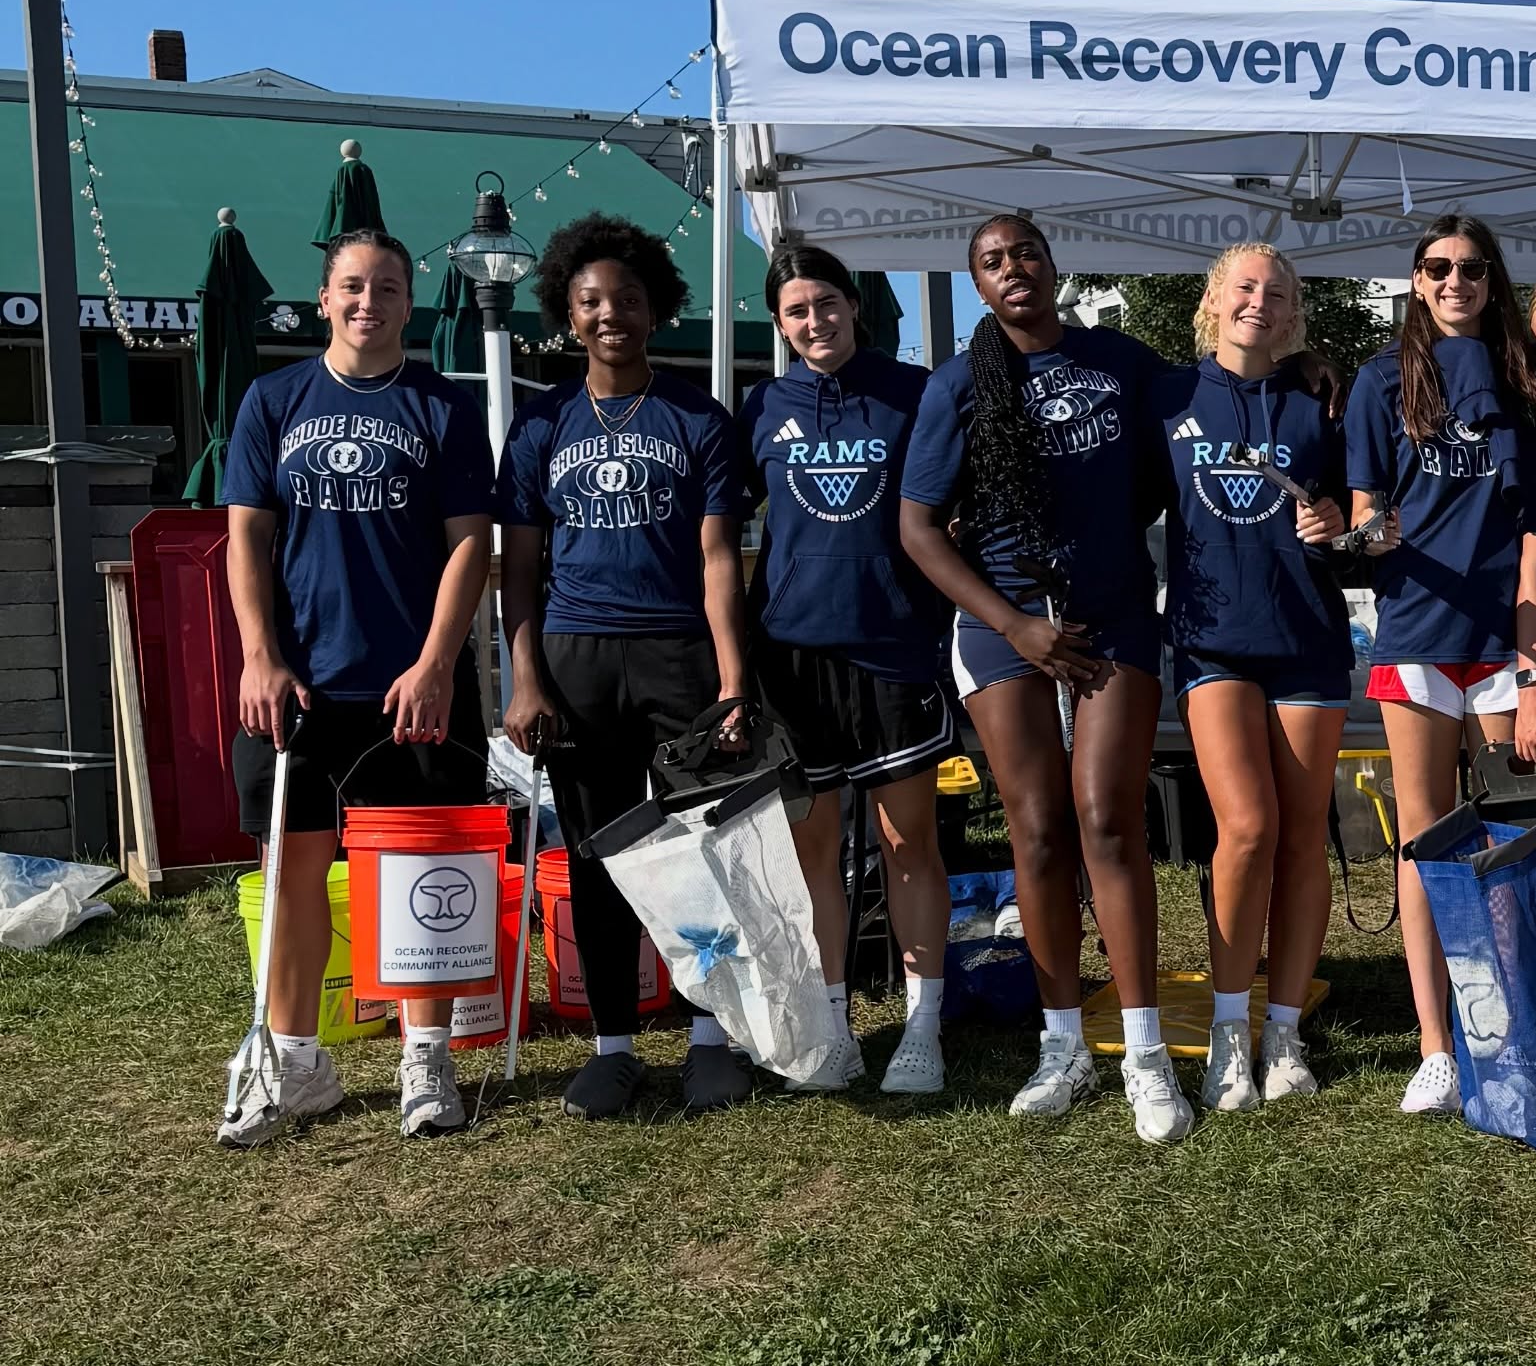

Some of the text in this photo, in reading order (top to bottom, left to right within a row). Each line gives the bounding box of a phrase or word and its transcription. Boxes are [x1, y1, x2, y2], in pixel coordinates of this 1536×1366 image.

[779, 12, 1007, 79] Ocean
[1029, 20, 1344, 100] Recovery
[1044, 367, 1120, 395] ISLAND
[281, 415, 428, 468] RHODE ISLAND
[1040, 408, 1120, 455] AMS
[549, 433, 687, 489] RHODE ISLAND
[787, 439, 887, 464] RAMS
[289, 471, 409, 512] RAMS
[563, 487, 672, 529] RAMS
[1246, 512, 1270, 525] ISLAND
[384, 956, 494, 971] COMMUNITY ALLIANCE
[395, 944, 488, 957] OCEAN RECOVERY
[452, 1002, 491, 1014] COVERY
[454, 1013, 500, 1026] ALLIANCE
